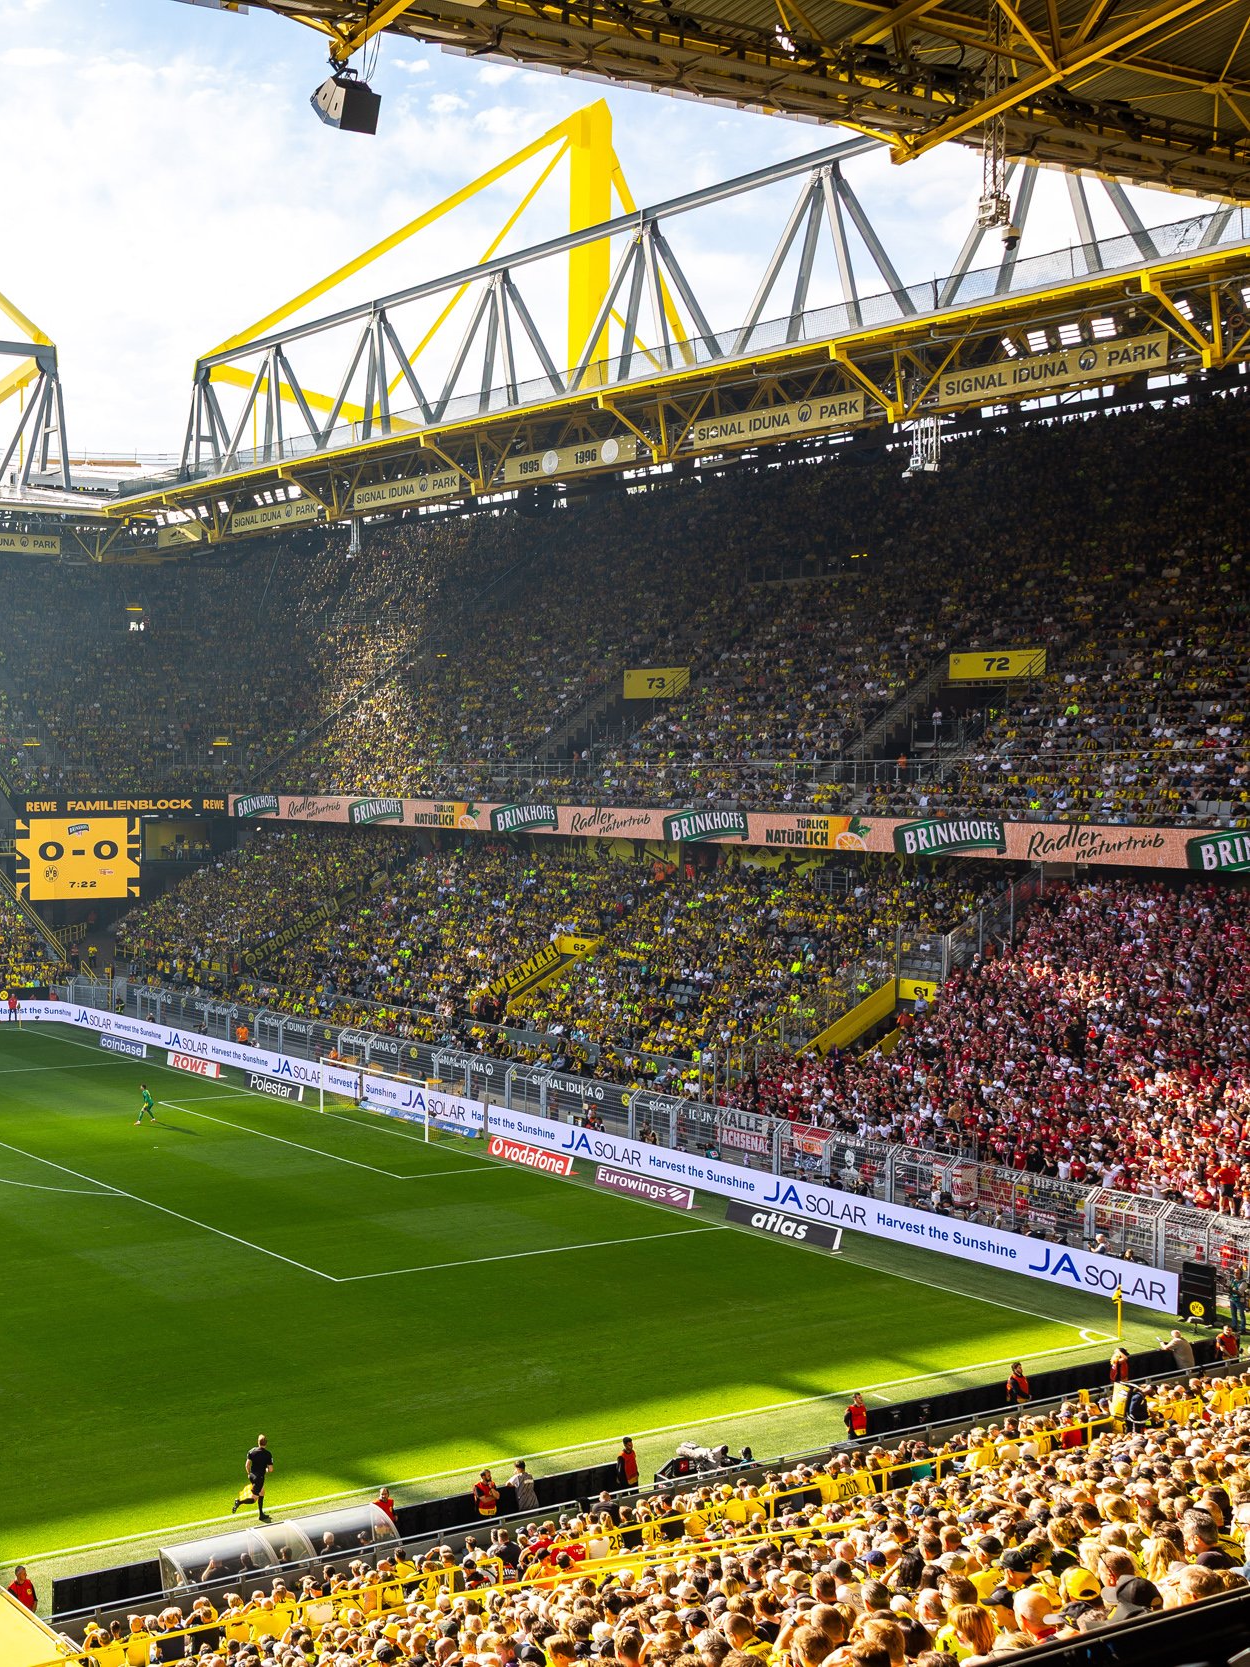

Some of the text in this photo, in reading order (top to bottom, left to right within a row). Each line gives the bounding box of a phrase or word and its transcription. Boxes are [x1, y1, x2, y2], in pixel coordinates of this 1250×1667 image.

[945, 343, 1161, 397] SIGNAL IDUNA PARK
[698, 400, 858, 442] SIGNAL IDUNA PARK
[519, 460, 540, 475] 1995
[574, 449, 597, 465] 1996
[356, 476, 457, 505] SIGNAL IDUNA PARK
[234, 503, 316, 528] SIGNAL IDUNA PARK
[33, 540, 57, 549] PARK
[983, 657, 1010, 672] 72
[646, 677, 666, 690] 73
[26, 799, 225, 812] REWE FAMILIENBLOCK REWE
[288, 797, 317, 818] Radler
[414, 812, 454, 826] NATÜRLICH
[571, 806, 651, 836] Radler naturtrüb
[797, 819, 829, 829] TÜRLICH
[765, 828, 829, 846] NATÜRLICH
[1027, 825, 1165, 861] Radler naturtrüb
[573, 943, 586, 951] 62
[74, 1009, 112, 1031] JA SOLAR
[101, 1038, 141, 1056] coinbase
[164, 1031, 208, 1056] JA SOLAR
[172, 1054, 207, 1075] ROWE
[212, 1045, 268, 1067] Harvest Sunshine
[250, 1074, 292, 1098] Polestar
[328, 1074, 352, 1089] Harvest
[366, 1084, 397, 1100] Sunshine
[402, 1089, 426, 1112] JA
[428, 1099, 466, 1122] SOLAR
[502, 1119, 555, 1141] the Sunshine
[561, 1130, 642, 1168] JA SOLAR
[504, 1146, 565, 1175] vodafone
[597, 1168, 667, 1199] Eurowings
[648, 1155, 756, 1192] Harvest the Sunshine
[764, 1181, 867, 1227] JA SOLAR
[751, 1211, 809, 1241] atlas
[876, 1212, 1017, 1259] Harvest the Sunshine
[1028, 1248, 1166, 1306] JA SOLAR
